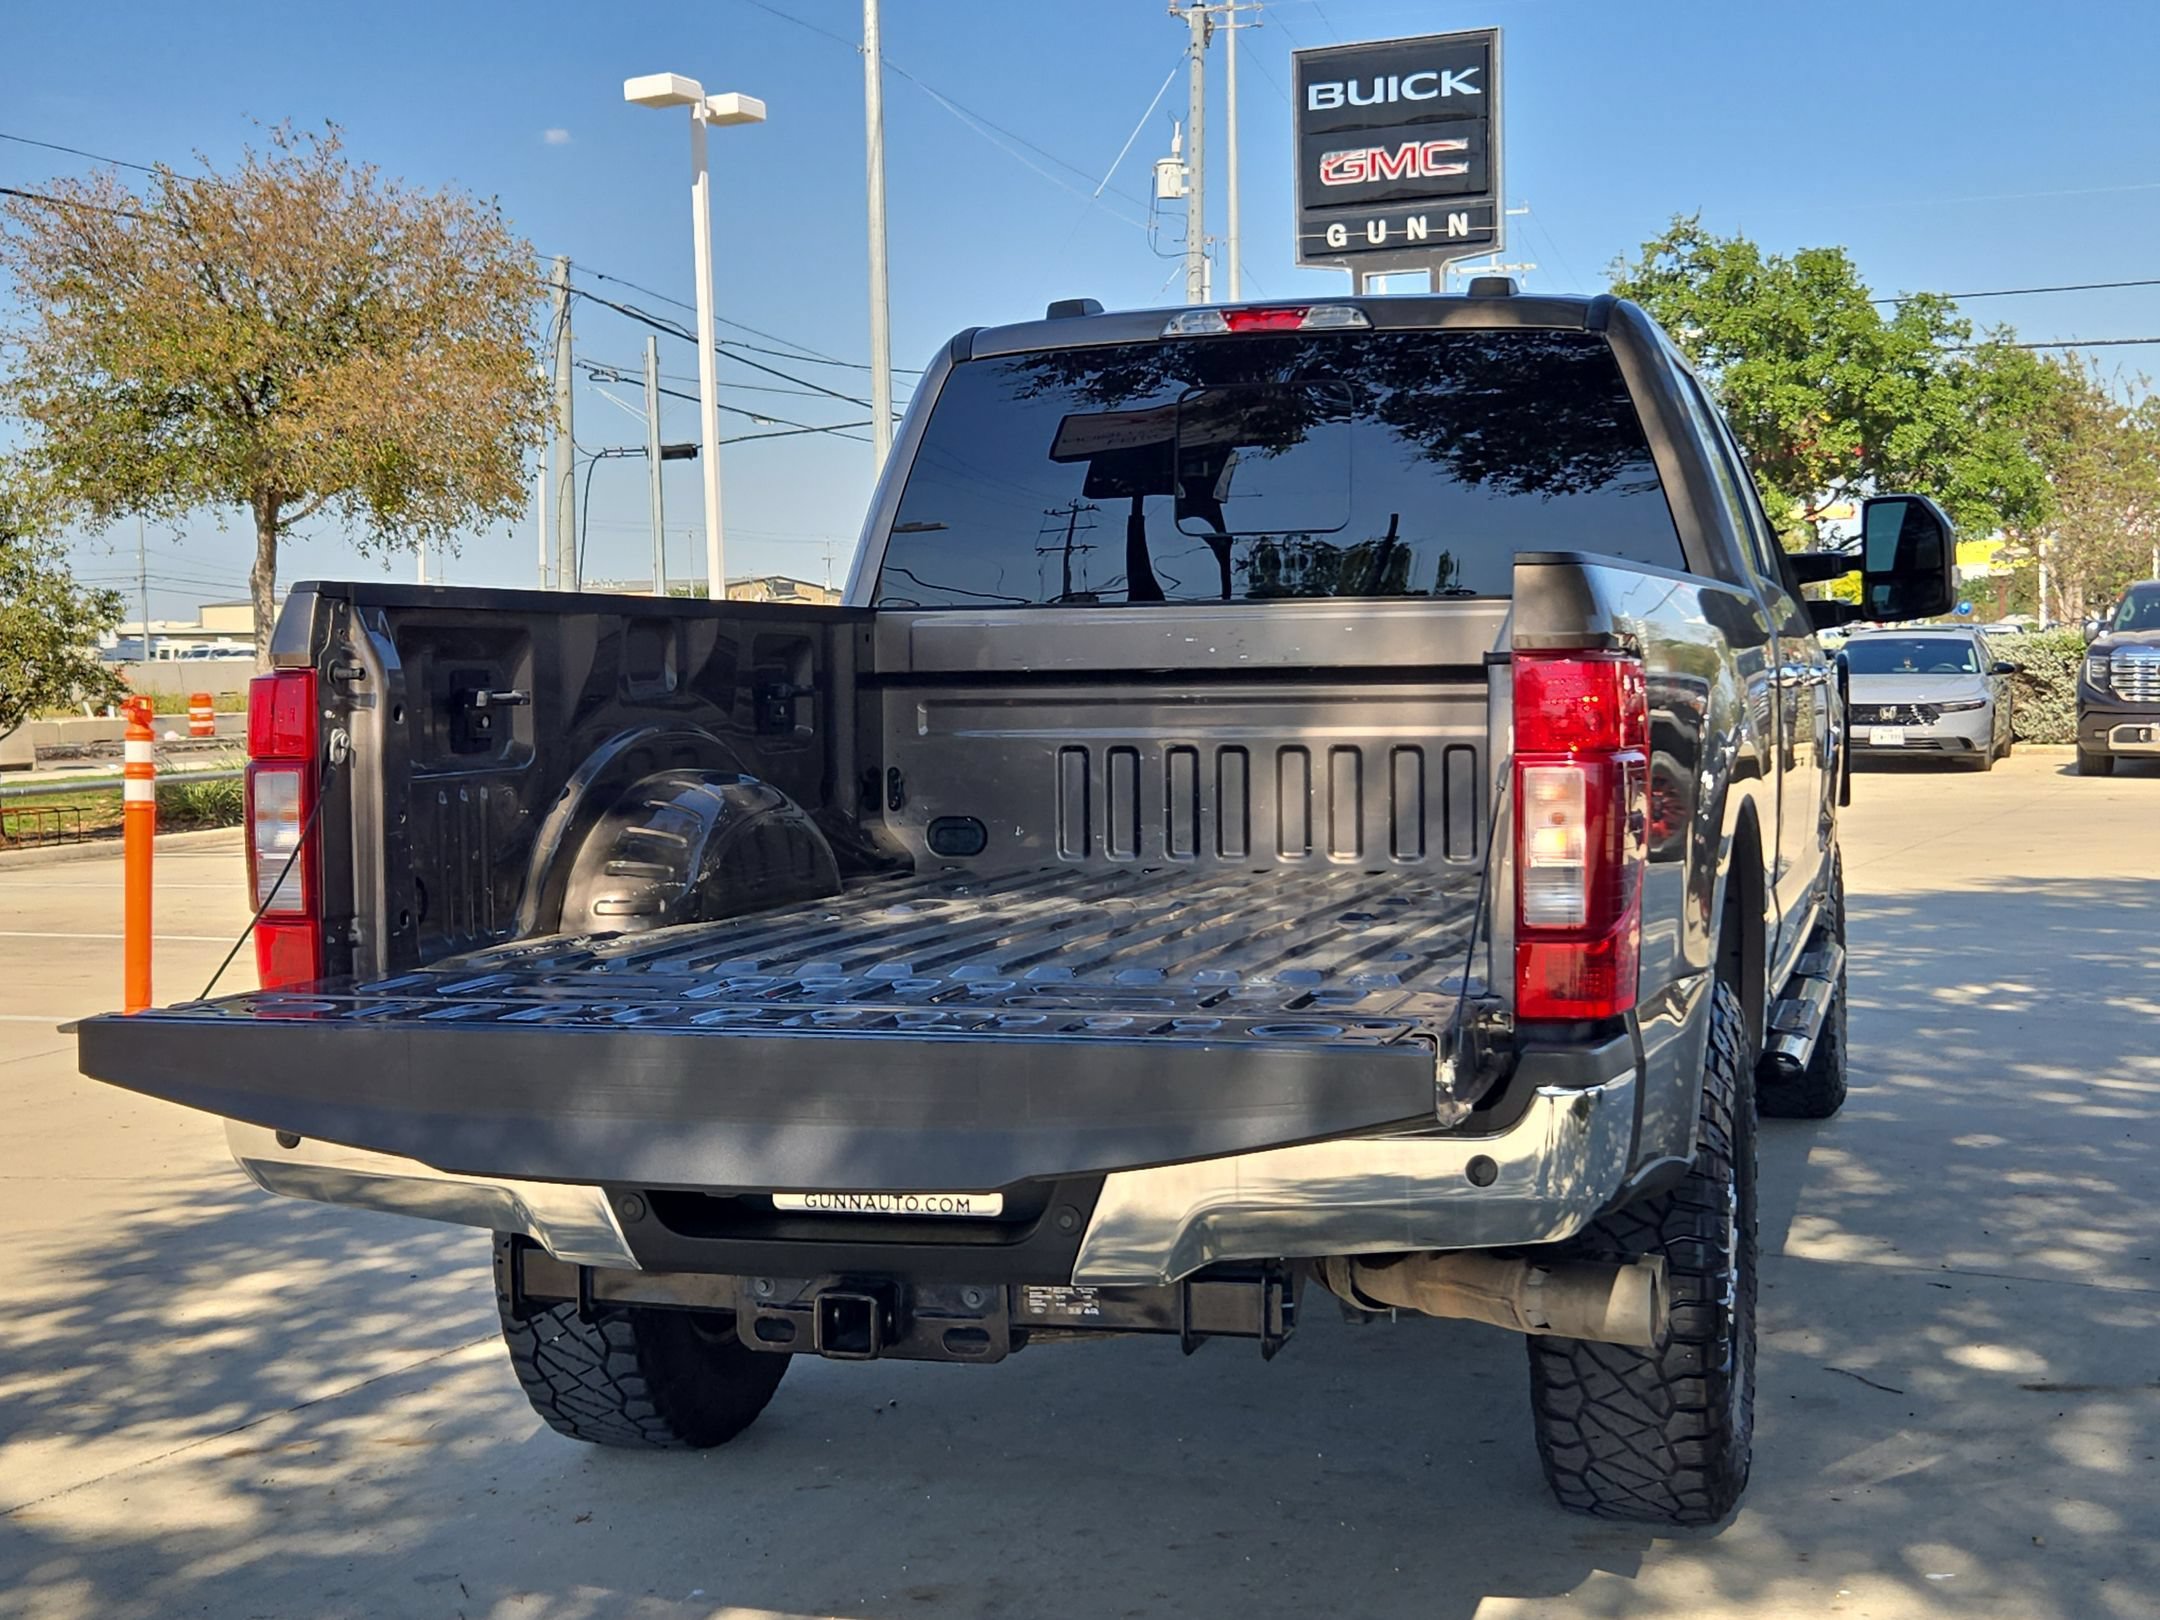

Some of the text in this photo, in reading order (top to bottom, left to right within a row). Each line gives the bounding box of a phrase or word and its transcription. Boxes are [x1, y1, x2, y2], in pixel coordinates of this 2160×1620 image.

[1308, 67, 1482, 110] BUICK
[1320, 137, 1469, 186] GMC
[1326, 212, 1468, 247] GUNN
[804, 1194, 971, 1213] GUNNAUTO.COM
